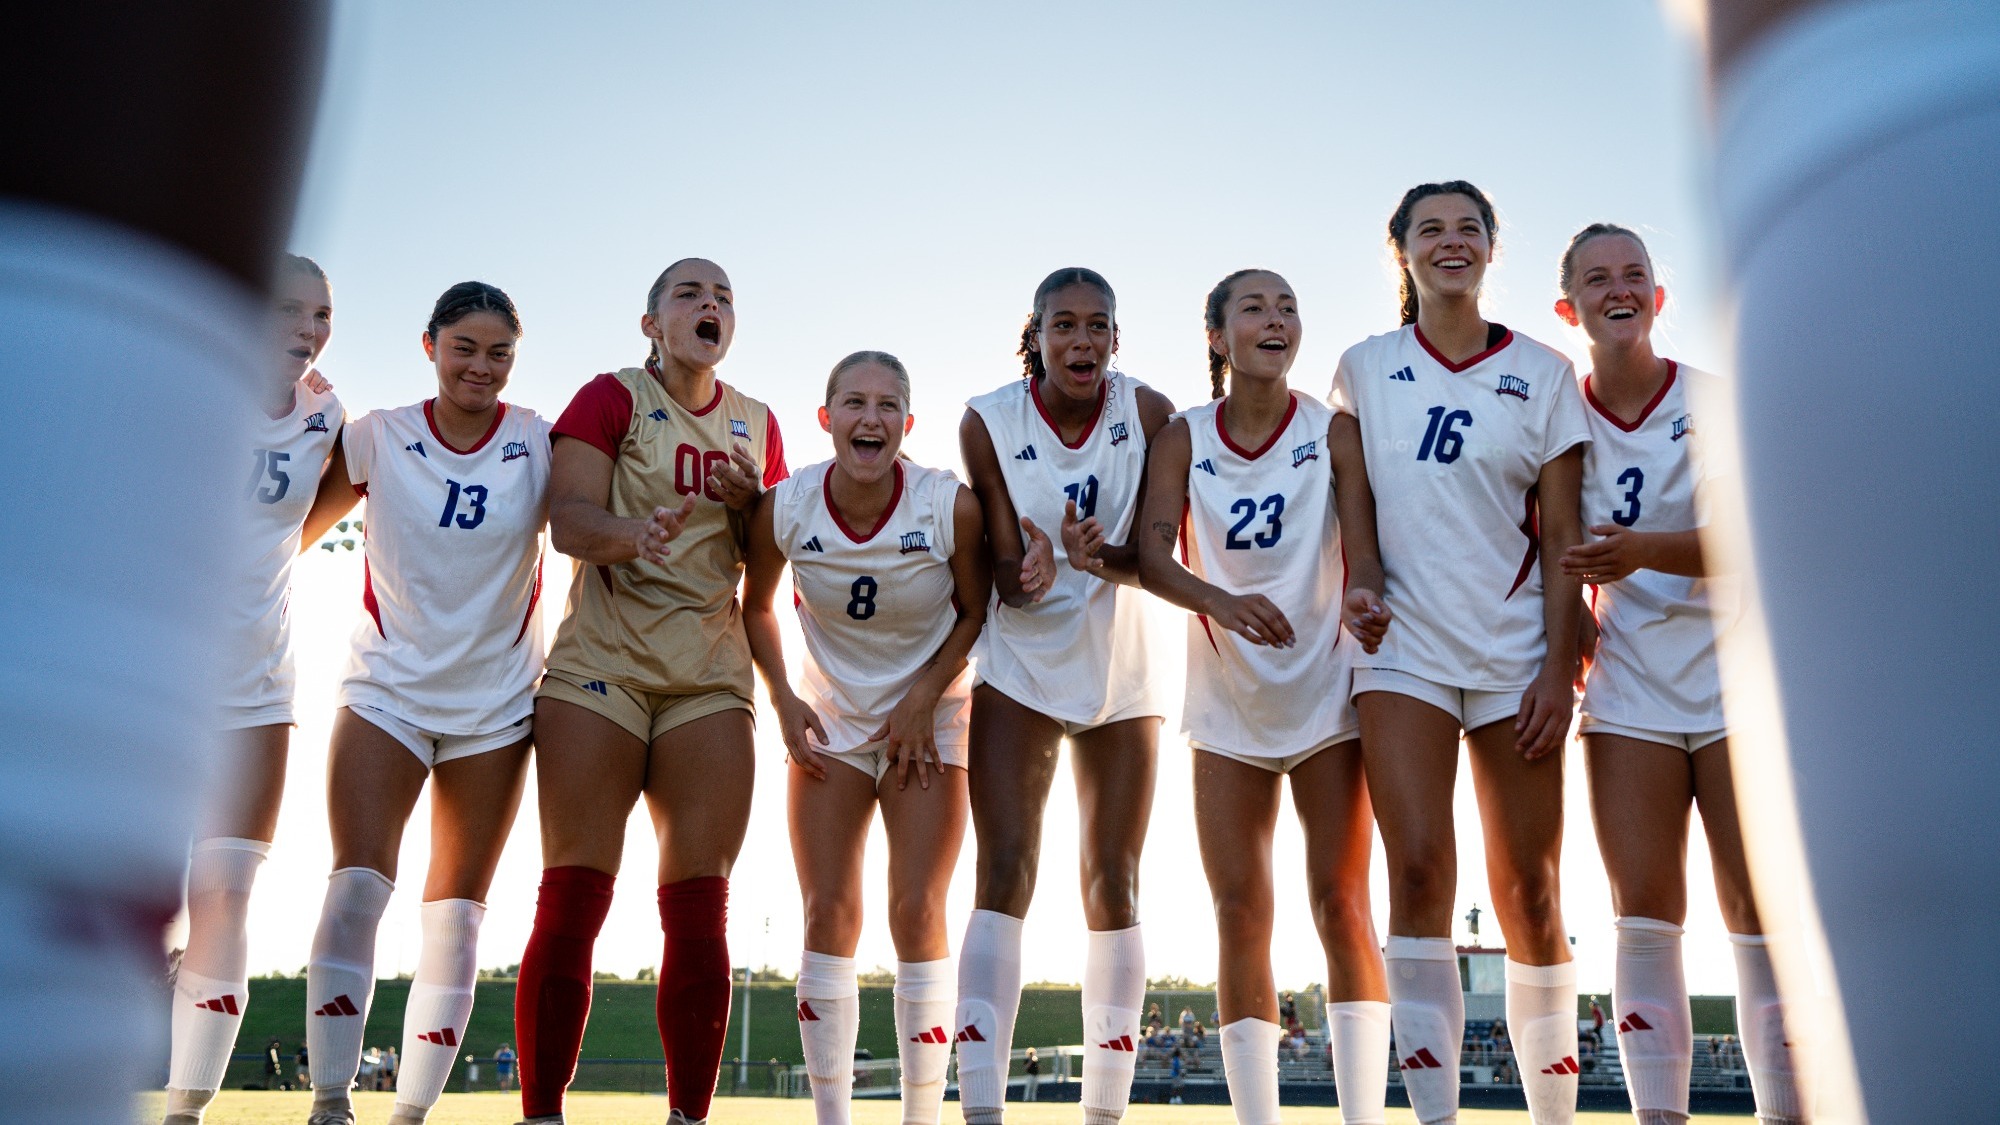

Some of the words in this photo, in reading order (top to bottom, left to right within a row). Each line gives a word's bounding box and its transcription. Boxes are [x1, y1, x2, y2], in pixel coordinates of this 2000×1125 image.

[1500, 375, 1529, 395] UWG
[502, 441, 527, 459] UWG
[1292, 440, 1316, 461] UWG
[1416, 405, 1473, 465] 16
[244, 448, 291, 505] 15
[1612, 466, 1644, 527] 3
[438, 478, 489, 530] 13
[1225, 493, 1285, 551] 23
[900, 531, 928, 549] UWG
[846, 575, 878, 621] 8
